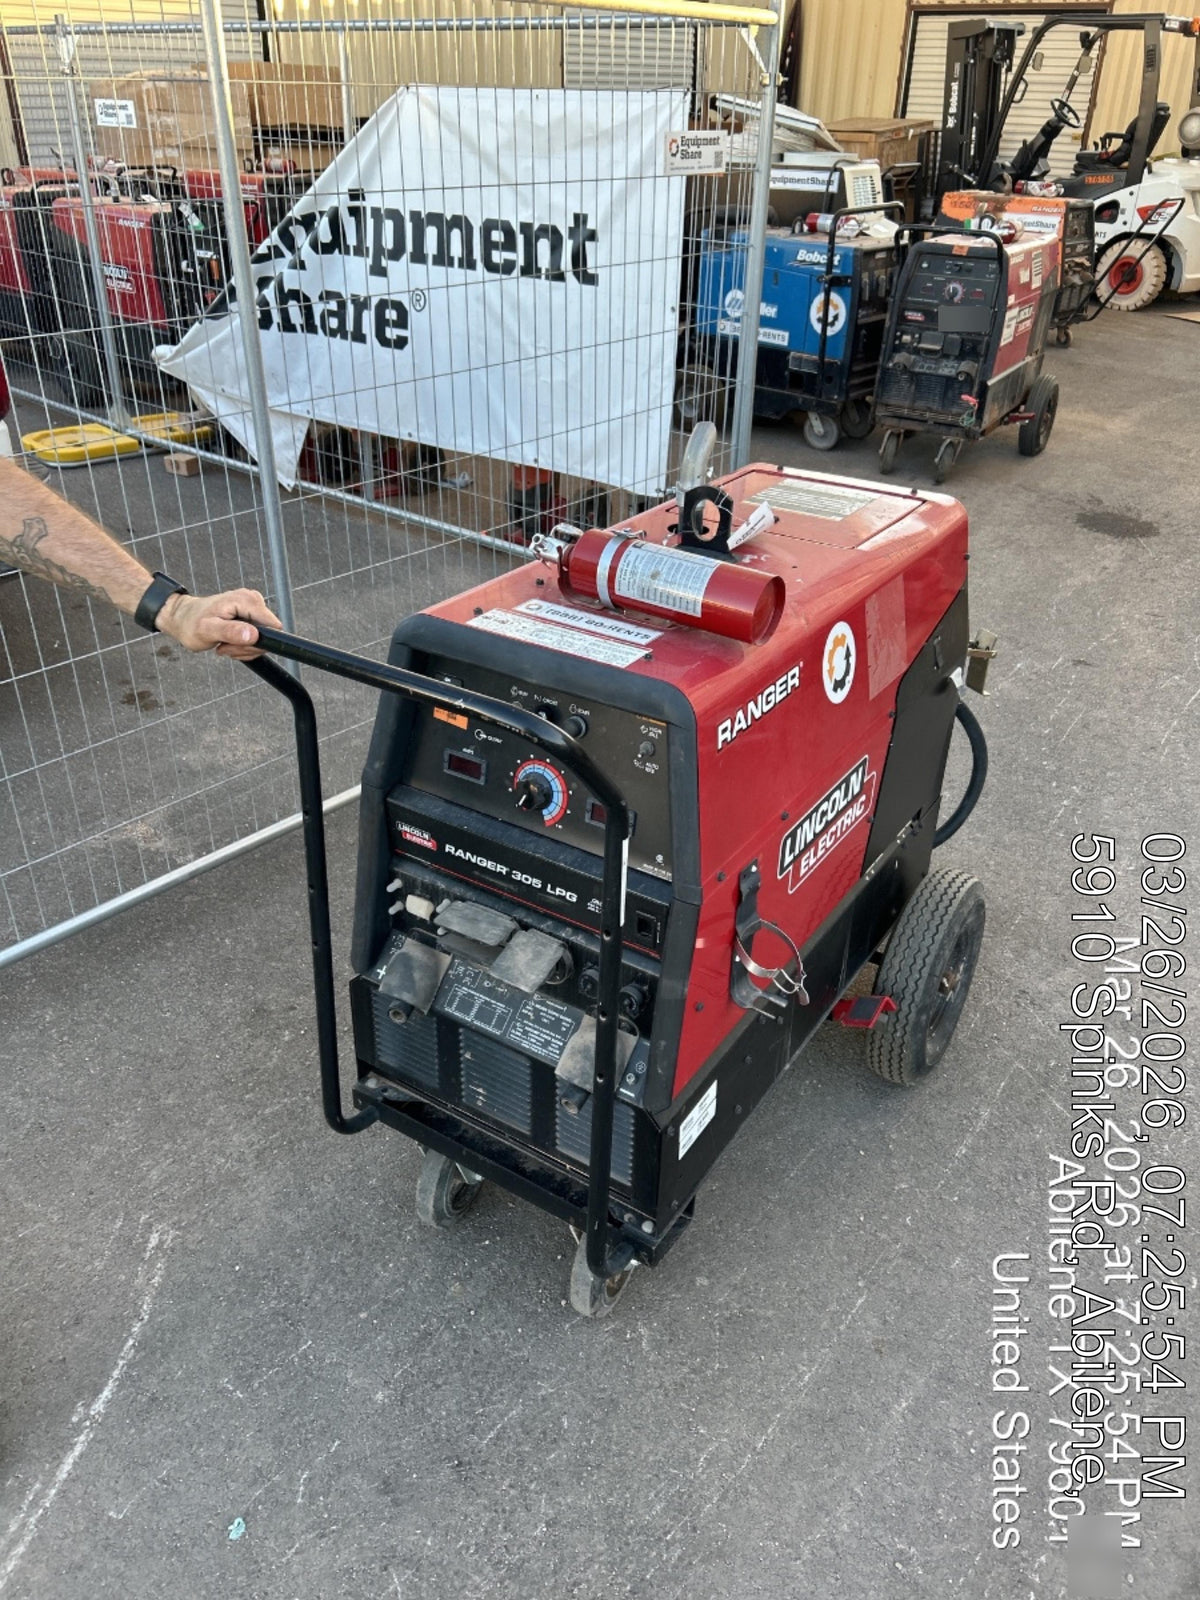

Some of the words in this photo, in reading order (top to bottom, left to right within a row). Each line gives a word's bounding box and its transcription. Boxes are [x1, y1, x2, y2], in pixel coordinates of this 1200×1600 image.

[680, 136, 720, 149] Equipment
[796, 249, 840, 266] Bobct
[717, 664, 800, 750] RANGER
[783, 767, 863, 868] LINCOLN
[801, 794, 866, 876] ELECTRIC
[443, 843, 509, 876] RANGER
[511, 869, 542, 889] 305
[546, 883, 579, 904] LPG
